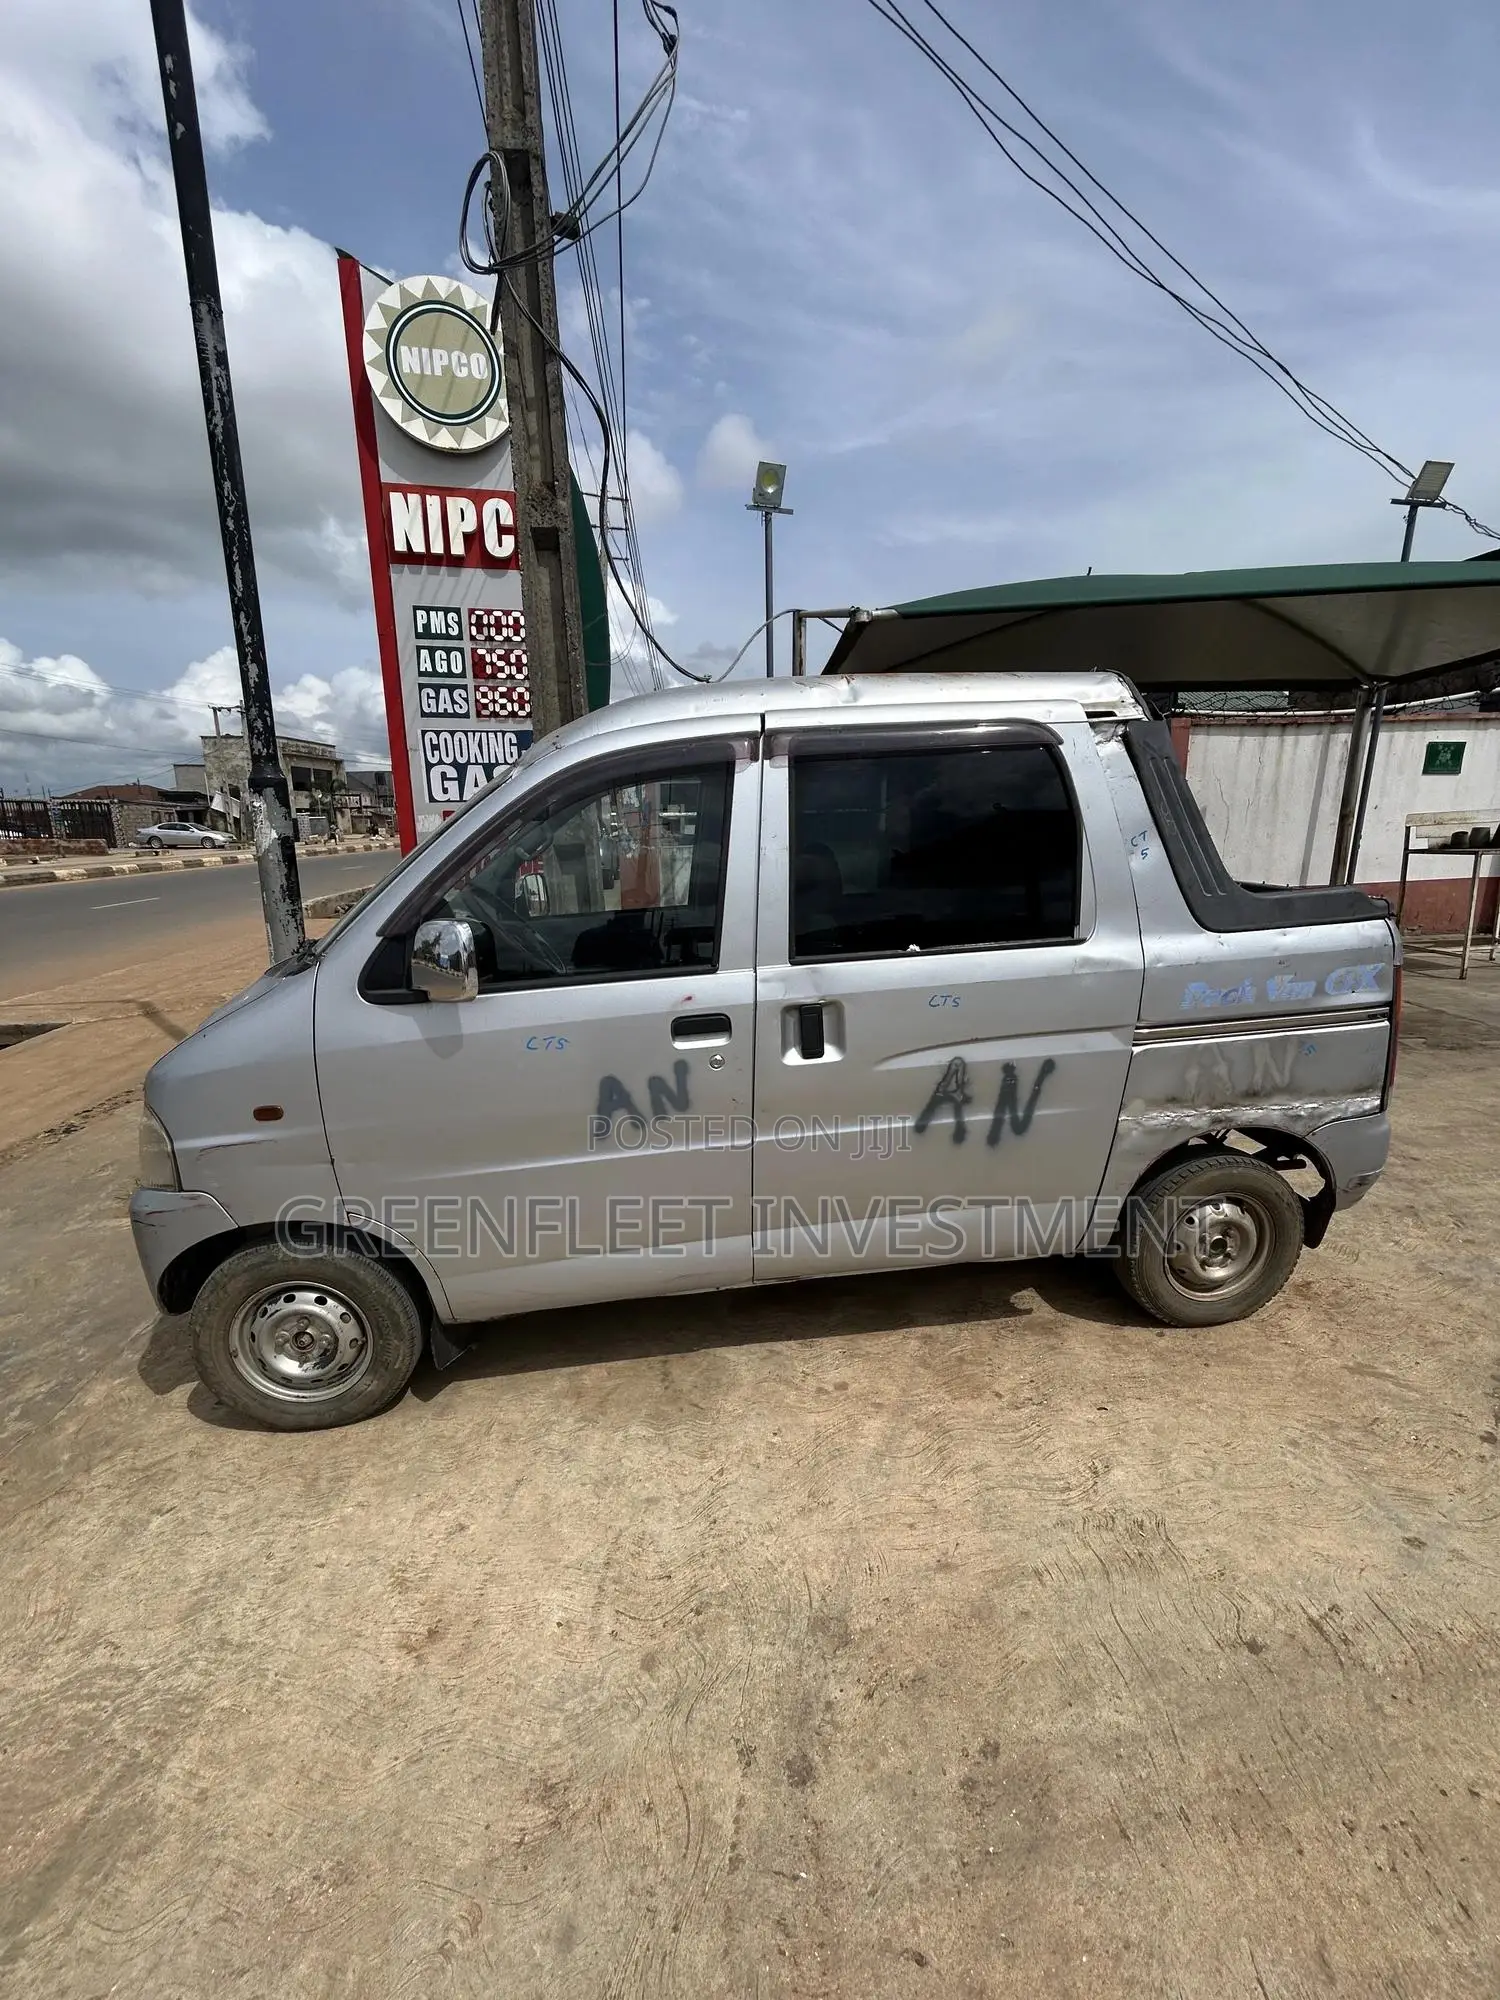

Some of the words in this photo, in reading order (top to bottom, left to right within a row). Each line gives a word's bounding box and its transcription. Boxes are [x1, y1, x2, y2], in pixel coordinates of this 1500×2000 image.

[400, 345, 488, 380] NIPCO
[390, 491, 515, 557] NIPC
[416, 610, 459, 635] PMS
[470, 610, 526, 641] 000
[419, 646, 463, 673] AGO
[476, 648, 528, 679] 750
[421, 687, 469, 714] GAS
[476, 686, 531, 716] 960
[424, 731, 518, 764] COOKING
[429, 764, 508, 801] GA
[596, 1058, 690, 1141] AN
[913, 1056, 1056, 1149] AN
